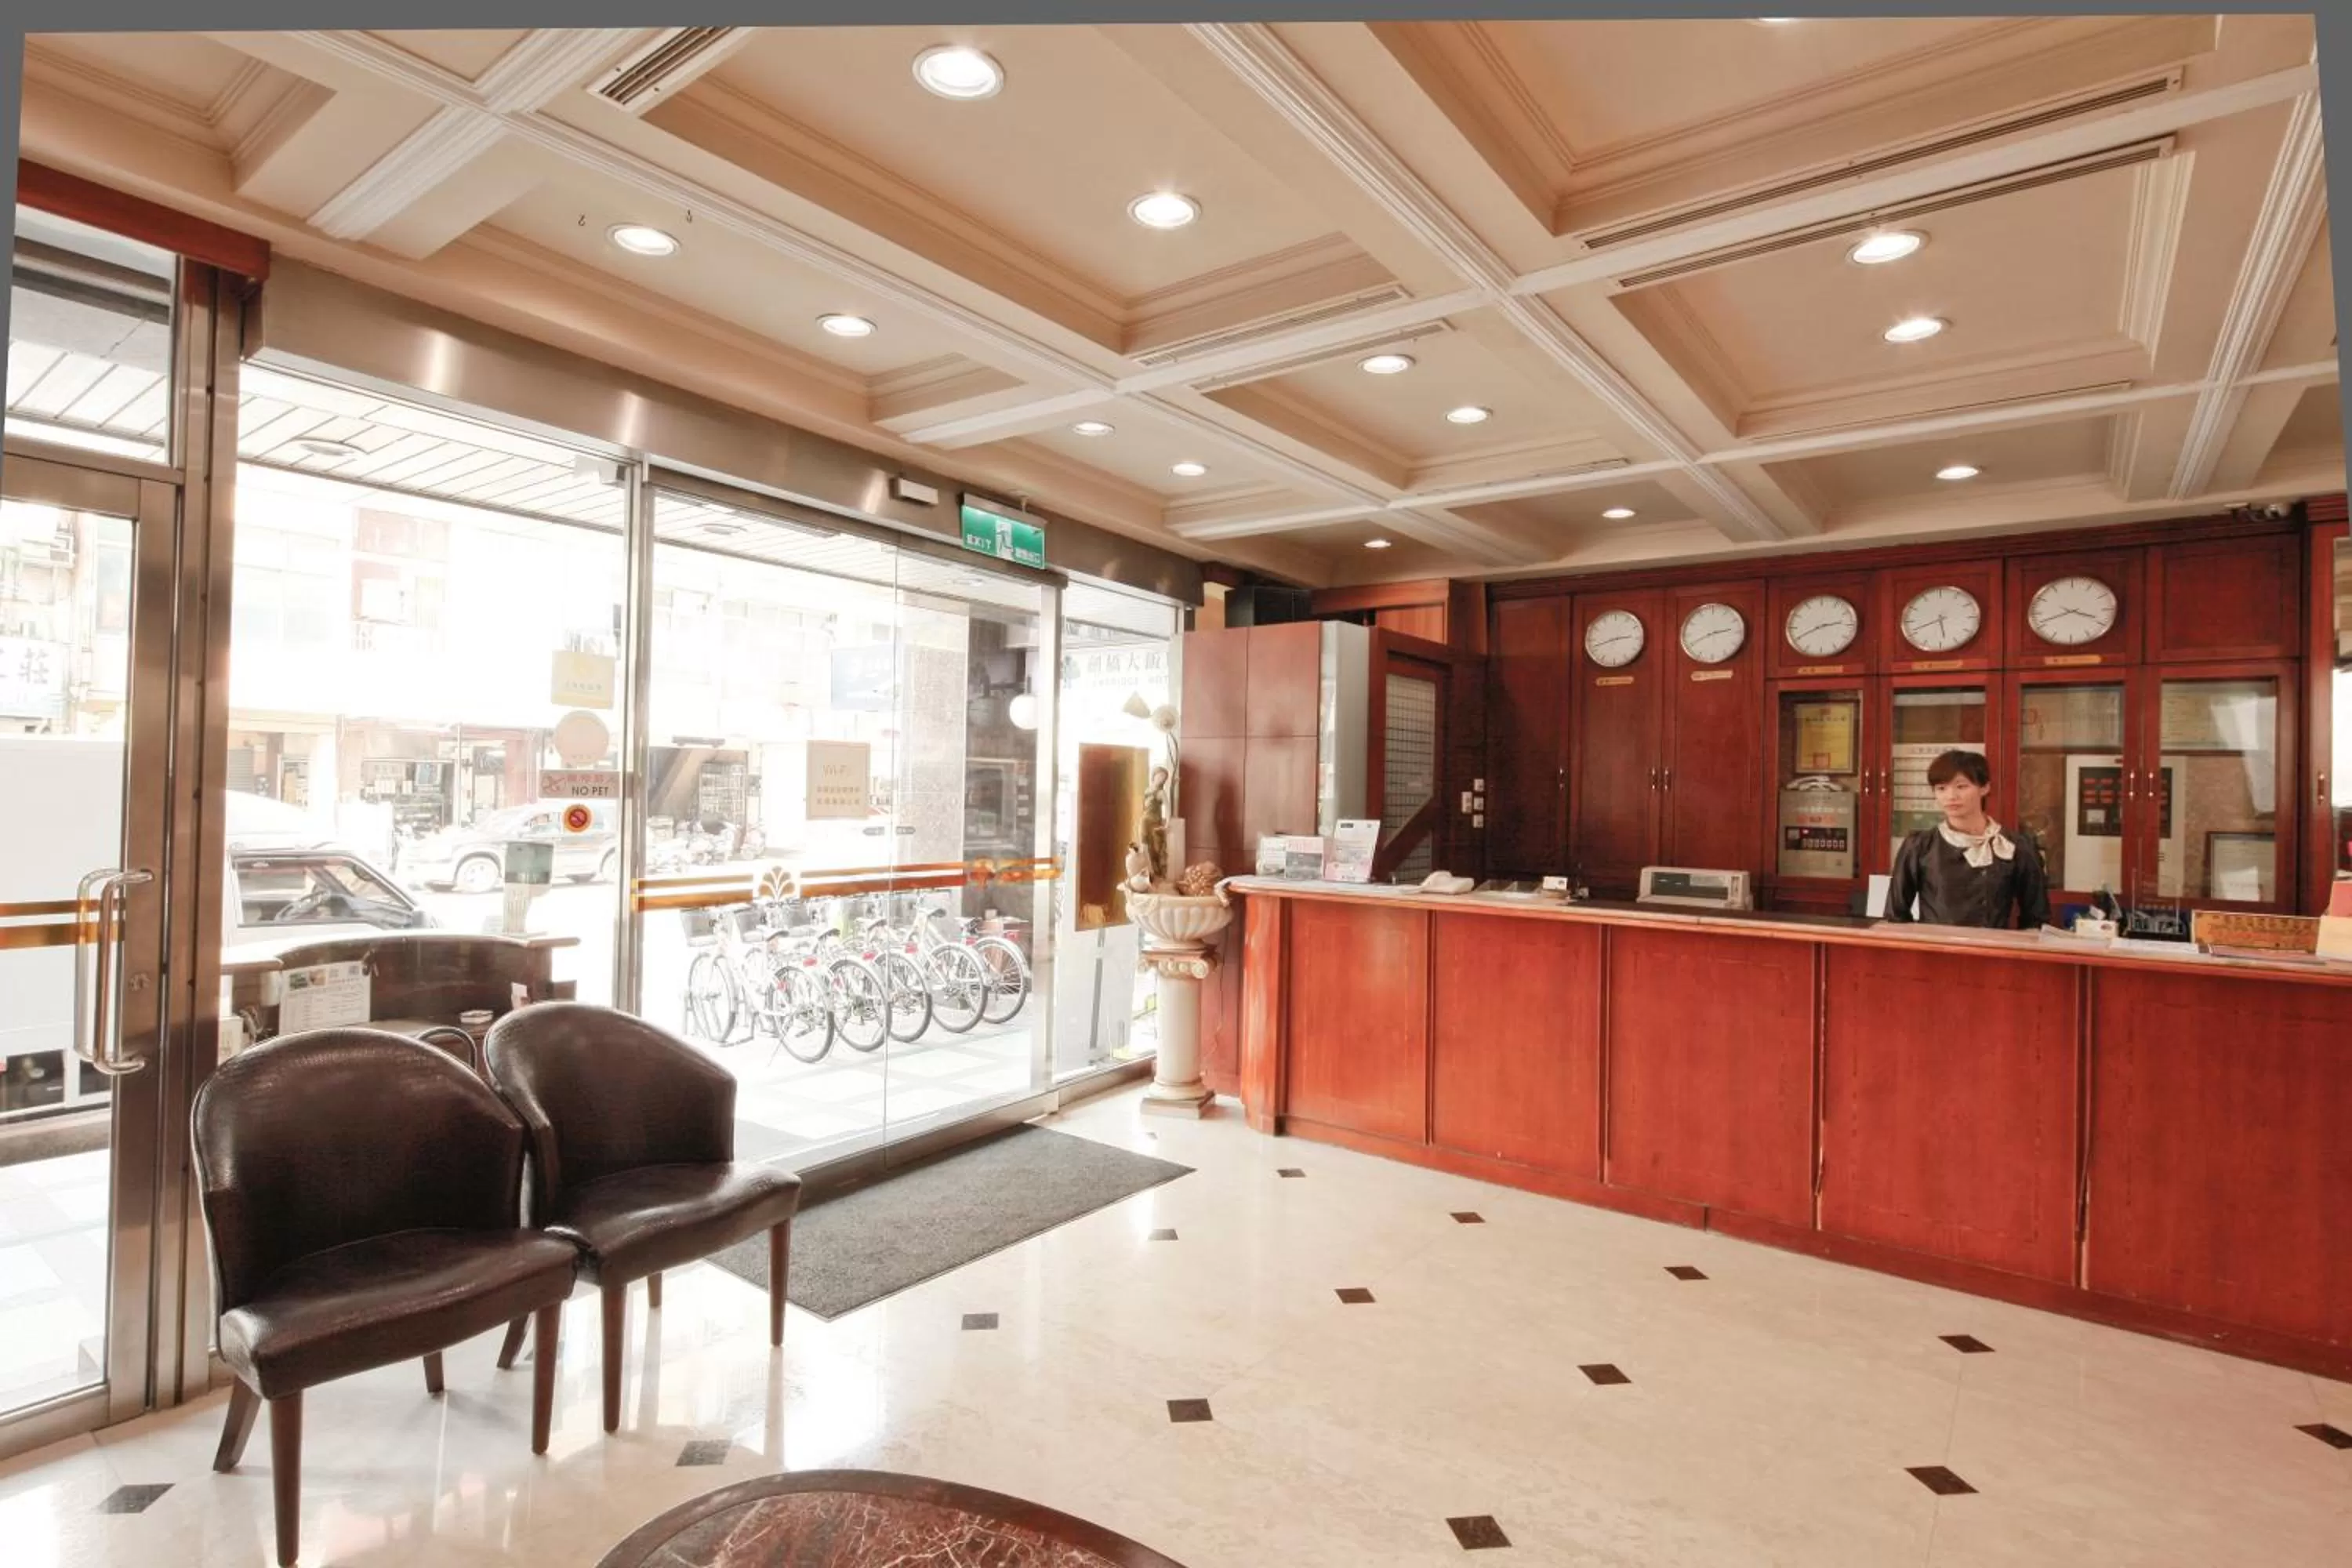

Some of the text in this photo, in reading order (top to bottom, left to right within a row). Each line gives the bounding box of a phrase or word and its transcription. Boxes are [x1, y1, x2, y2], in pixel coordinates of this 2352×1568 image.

[967, 533, 992, 550] EXIT
[572, 786, 609, 796] NO PET
